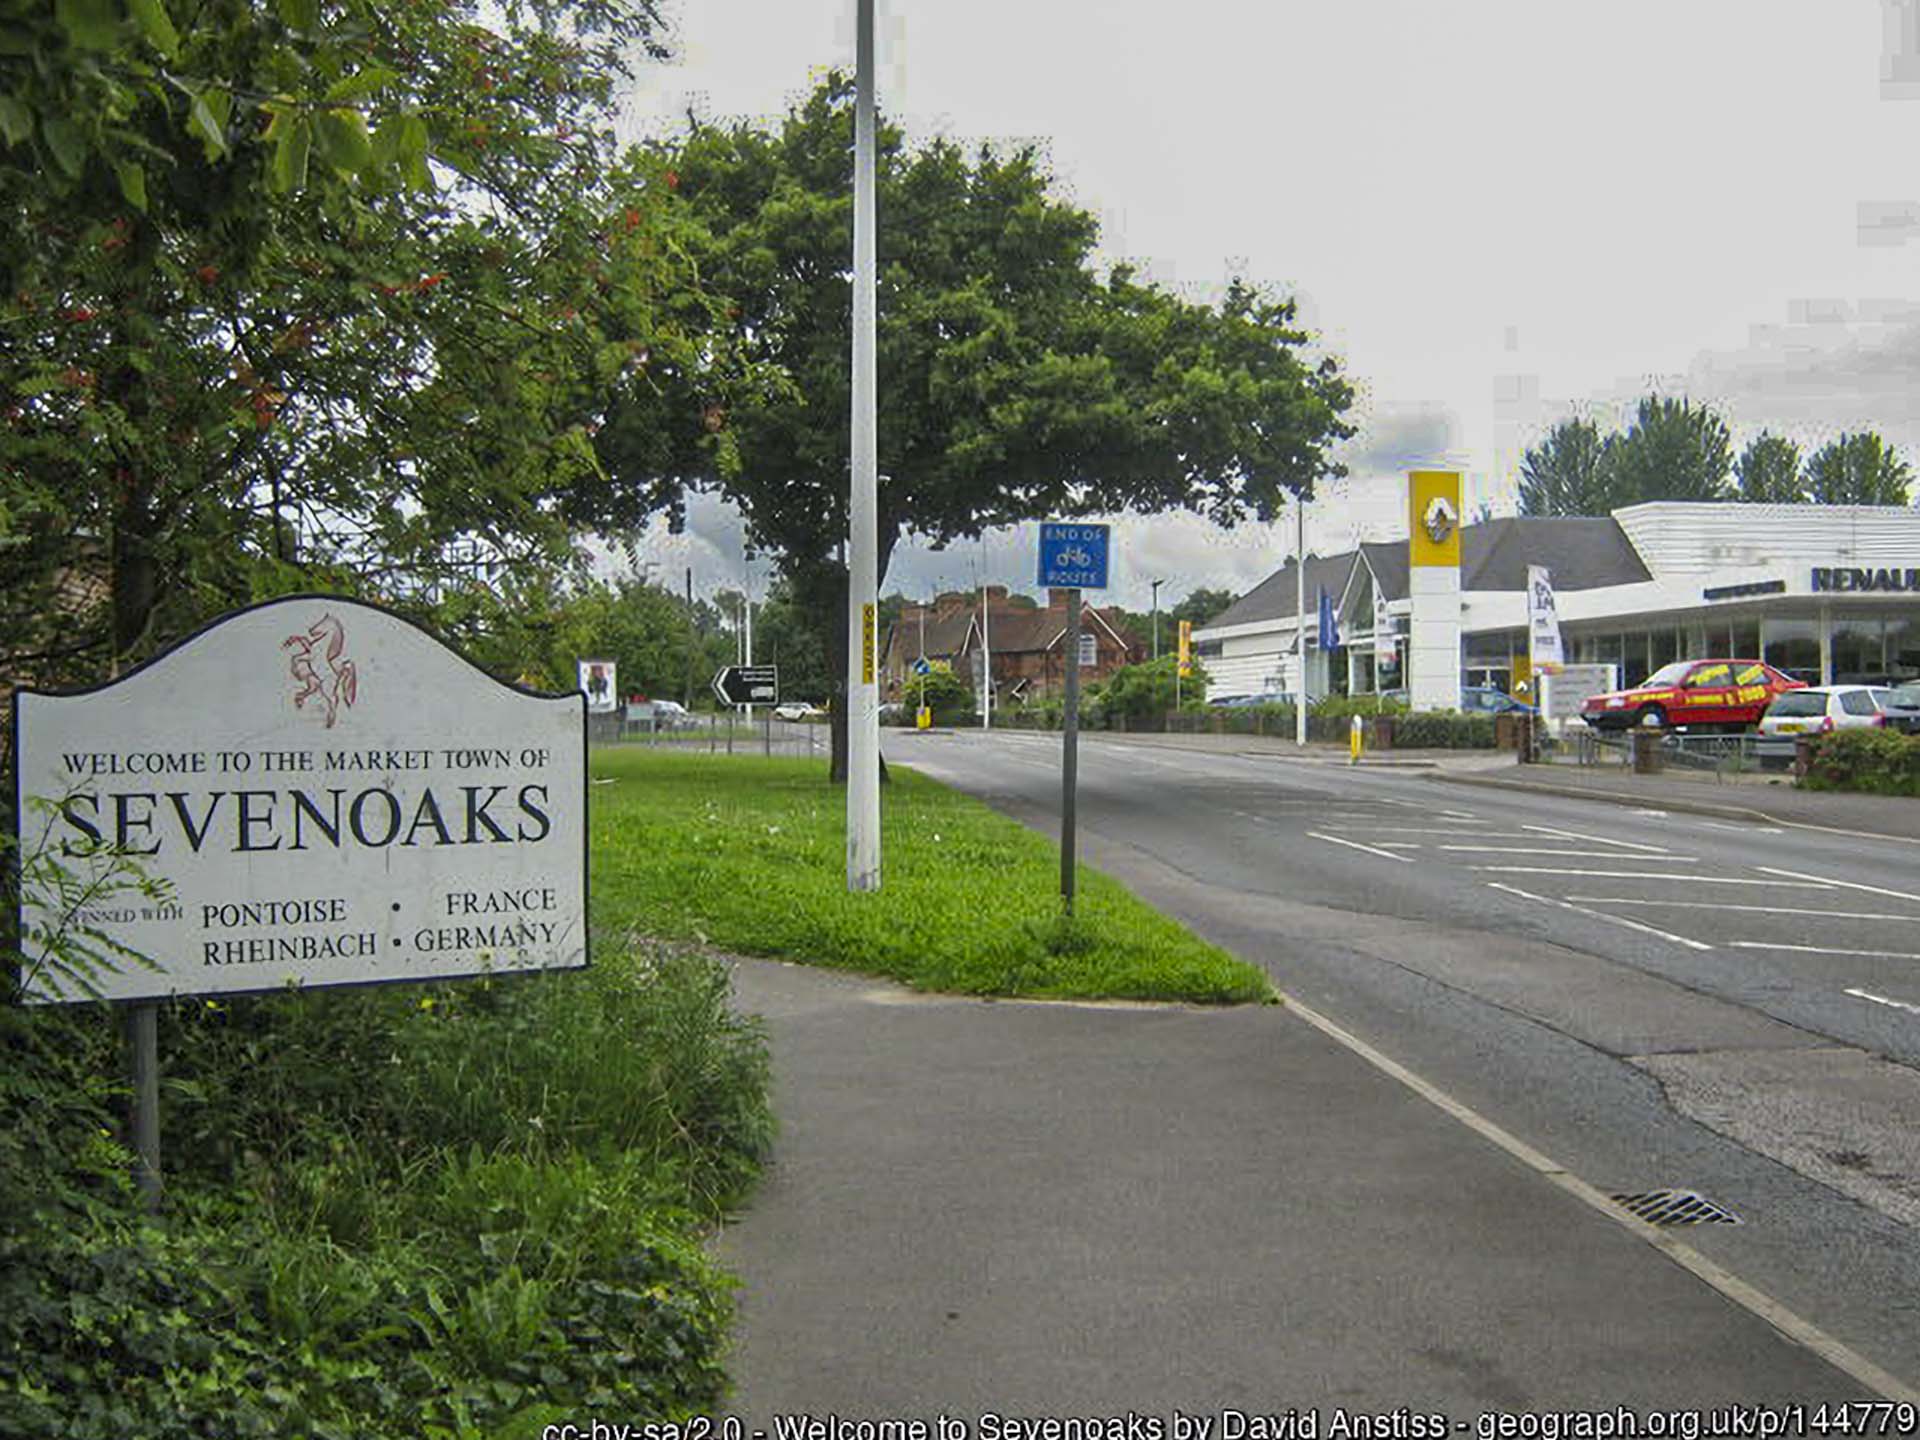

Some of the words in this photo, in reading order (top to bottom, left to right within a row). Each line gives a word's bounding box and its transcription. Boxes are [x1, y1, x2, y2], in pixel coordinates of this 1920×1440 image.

[1046, 527, 1077, 541] END
[1083, 526, 1105, 541] OF
[63, 752, 206, 774] WELCOME
[217, 752, 251, 773] TO
[260, 751, 313, 772] THE
[325, 750, 433, 770] MARKET
[439, 749, 511, 769] TOWN
[520, 748, 551, 768] OF
[61, 784, 551, 857] SEVENOAKS
[141, 905, 184, 921] WITH
[203, 899, 347, 928] PONTOISE
[446, 887, 557, 916] FRANCE
[204, 933, 377, 966] RHEINBACH
[414, 922, 558, 952] GERMANY
